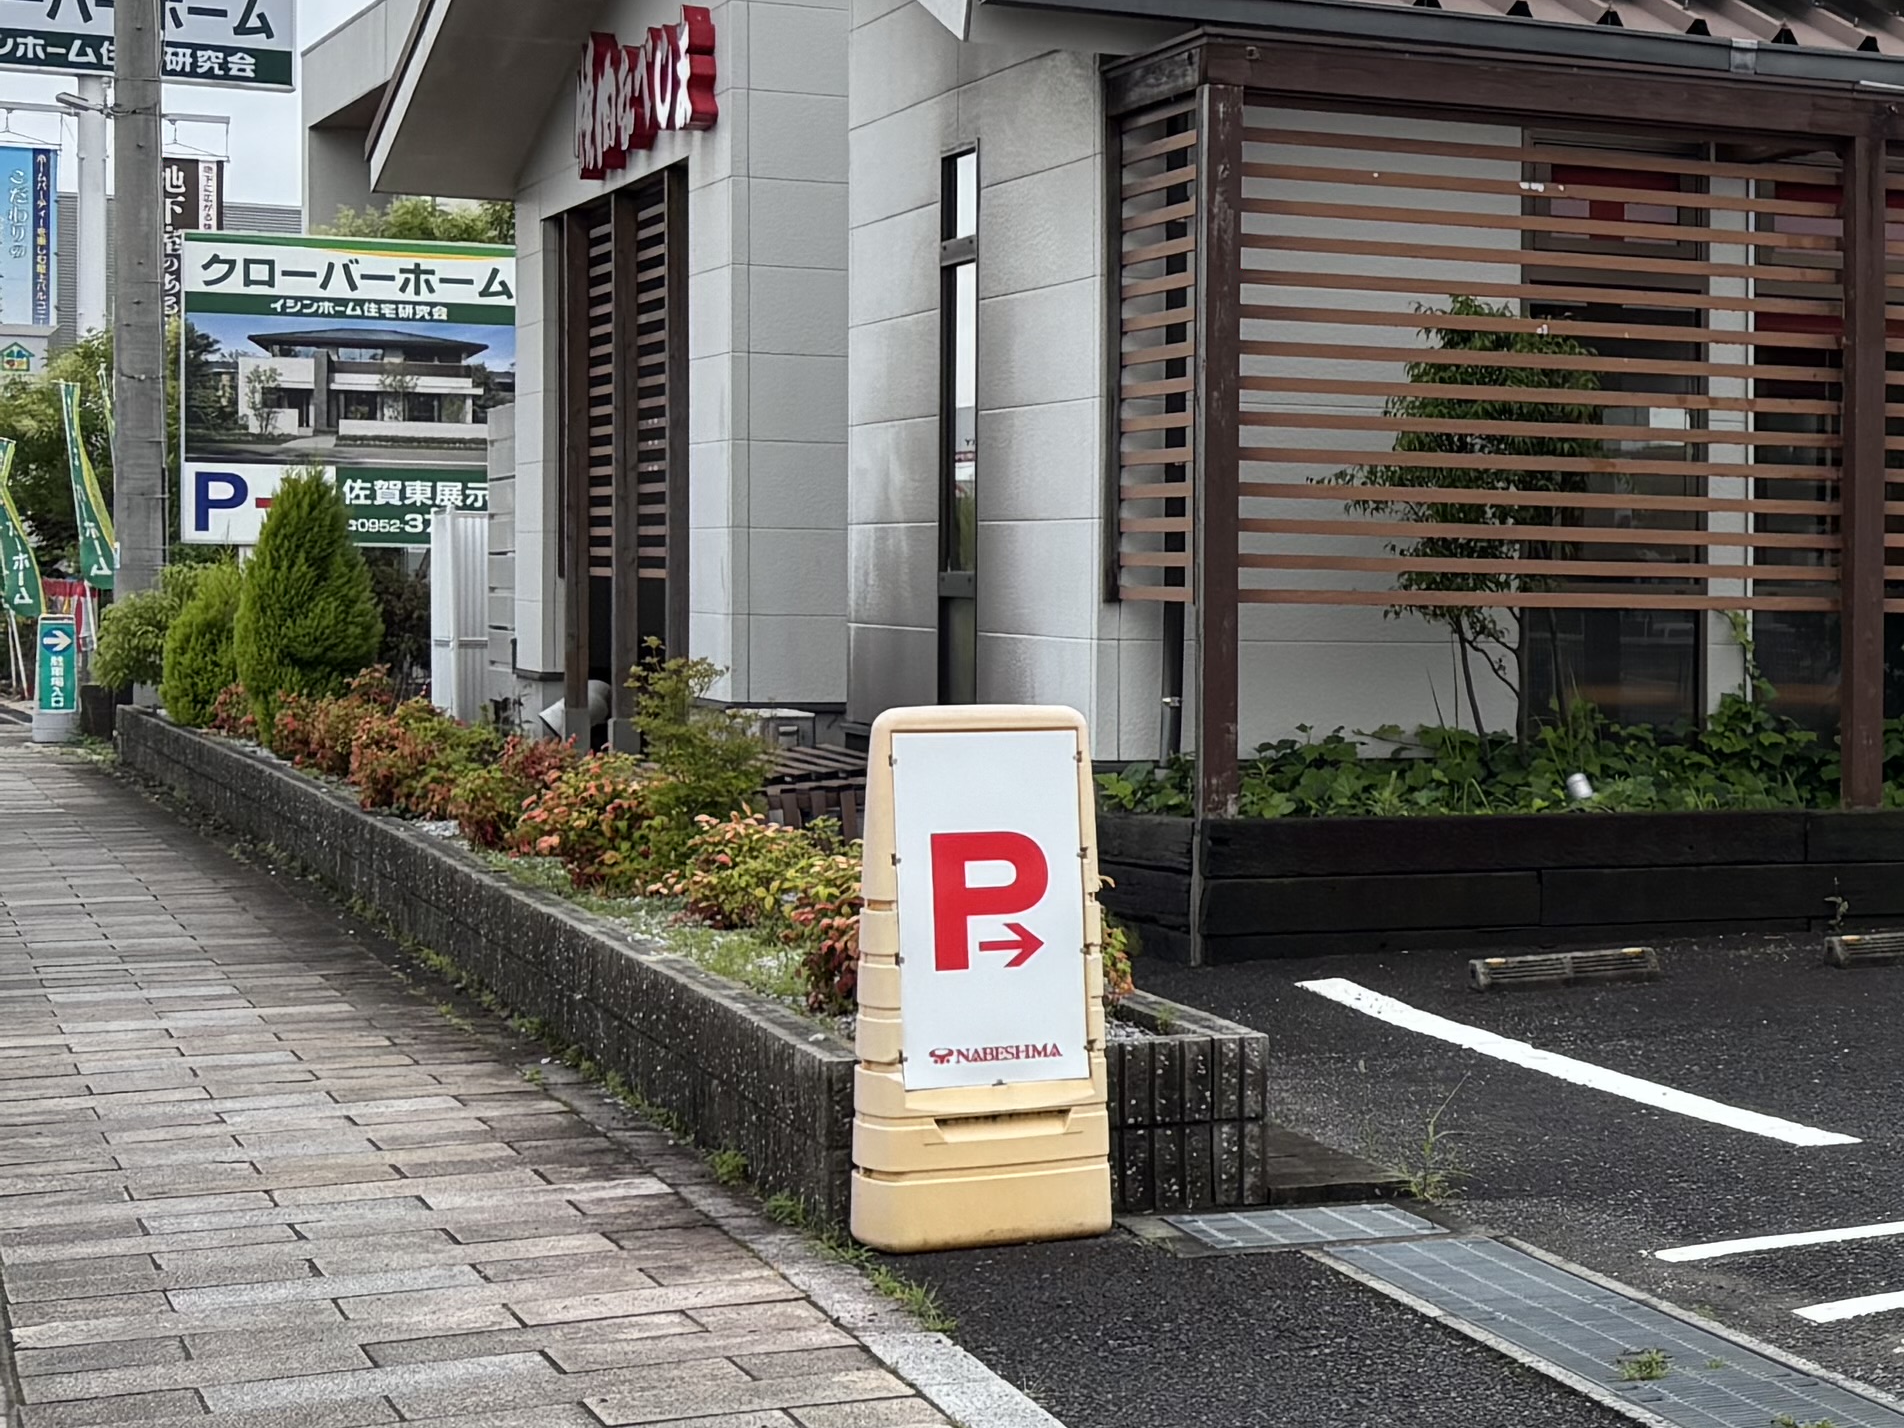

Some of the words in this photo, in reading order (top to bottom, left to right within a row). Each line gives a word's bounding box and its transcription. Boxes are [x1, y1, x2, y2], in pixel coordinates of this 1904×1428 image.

[0, 36, 256, 77] ホーム研究会
[201, 253, 514, 300] クローバーホーム
[270, 299, 449, 320] イシンホーム住宅研究会
[194, 471, 249, 532] P
[930, 830, 1049, 972] P
